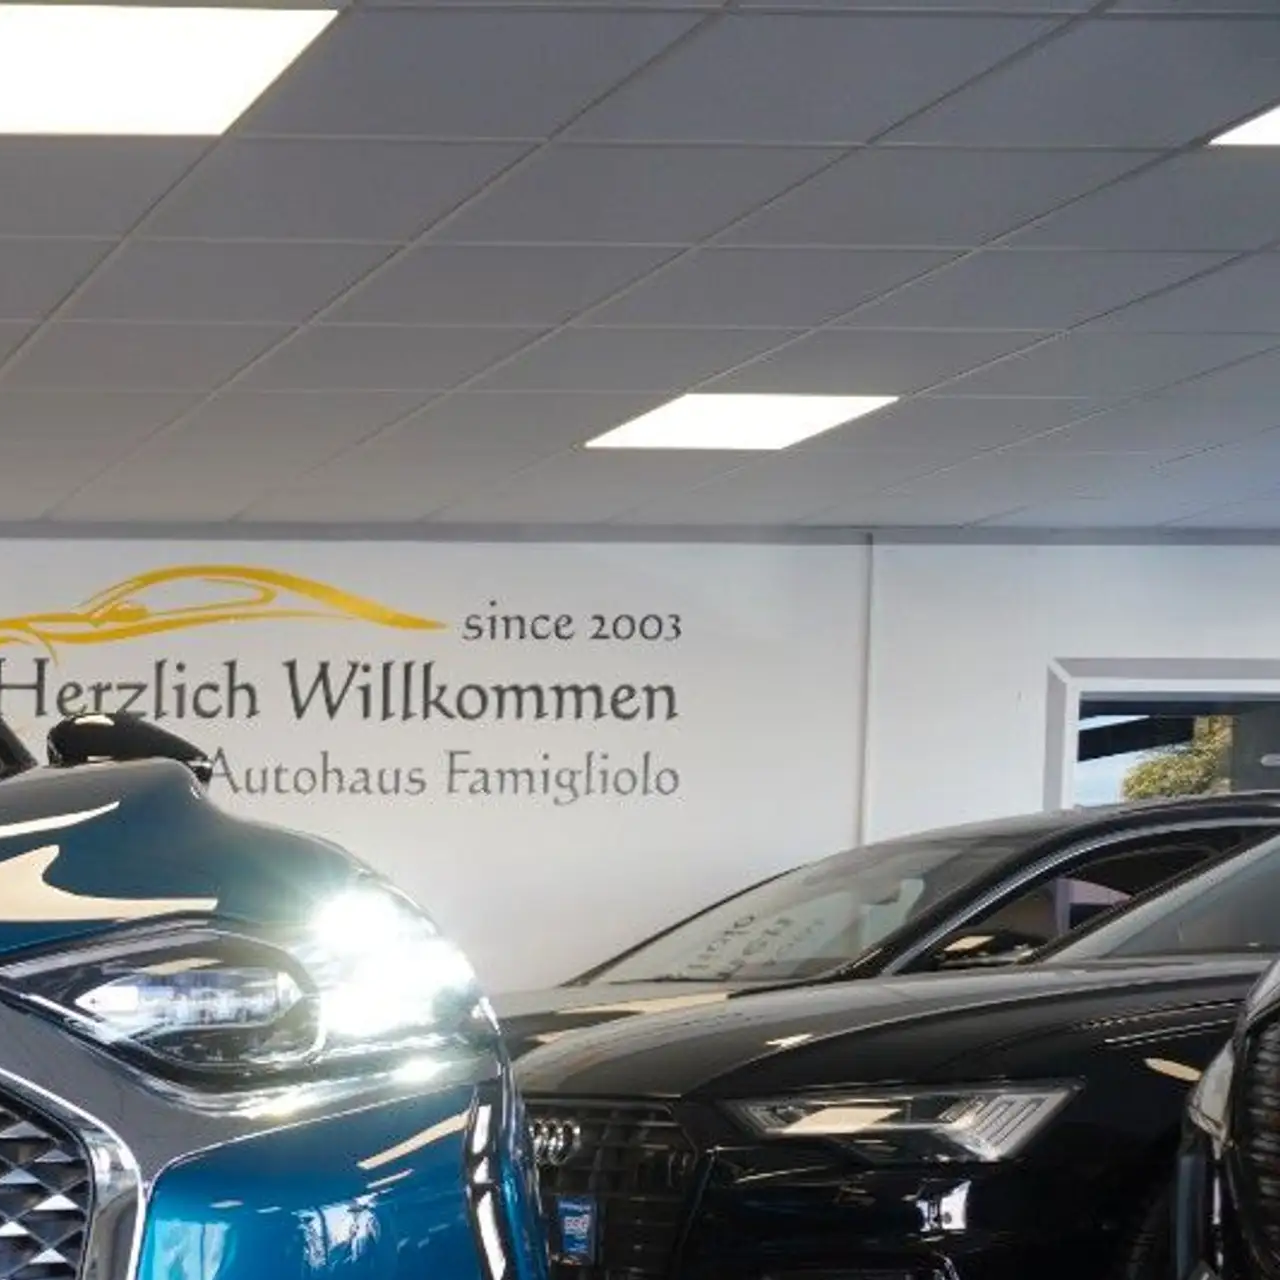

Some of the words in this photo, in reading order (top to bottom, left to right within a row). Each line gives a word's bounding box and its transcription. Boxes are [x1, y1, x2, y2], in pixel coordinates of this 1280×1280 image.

[462, 600, 576, 641] since
[589, 612, 683, 641] 2003
[282, 657, 680, 722] Willkommen
[207, 746, 427, 797] Autohaus
[445, 749, 681, 807] Famigliolo
